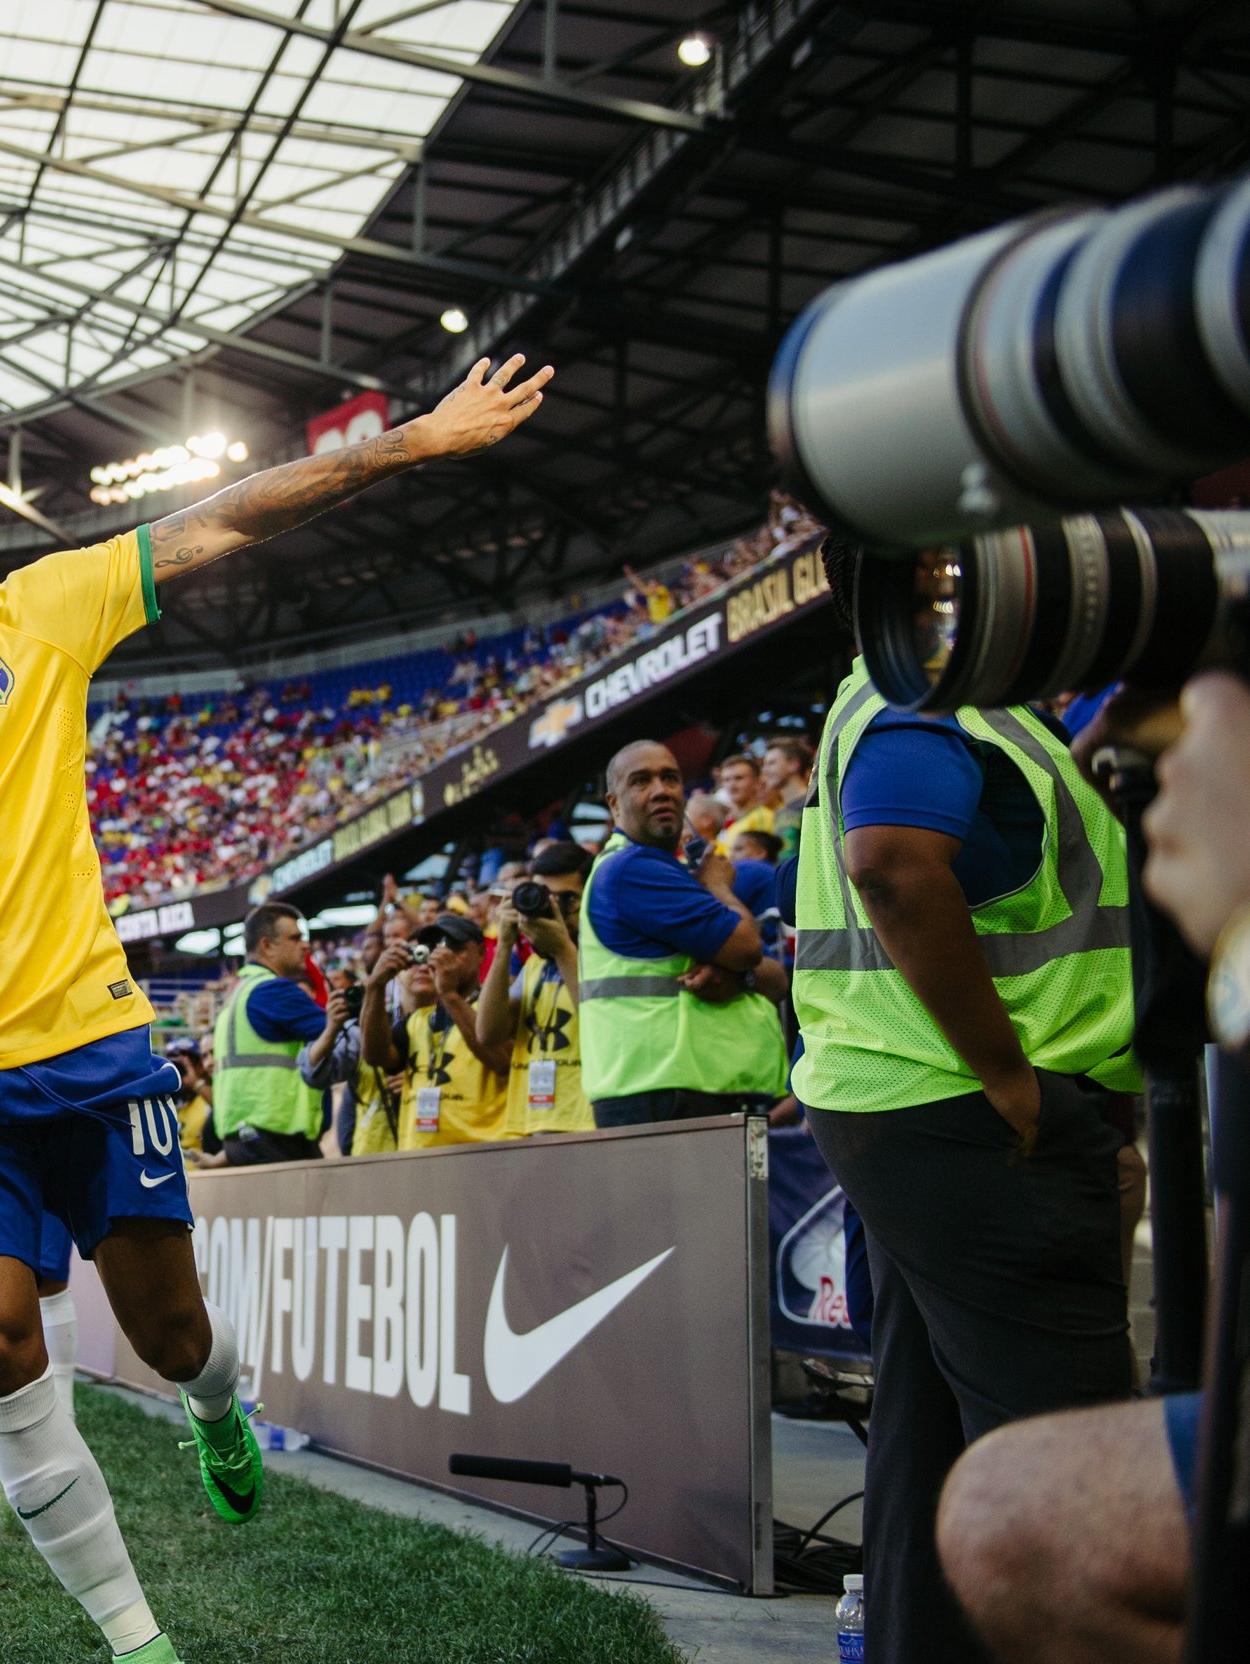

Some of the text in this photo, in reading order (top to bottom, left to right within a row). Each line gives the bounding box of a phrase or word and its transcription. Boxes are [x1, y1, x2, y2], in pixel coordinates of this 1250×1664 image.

[726, 568, 796, 644] BRASIL
[584, 611, 724, 719] CHEVROLET
[128, 1096, 173, 1156] 10
